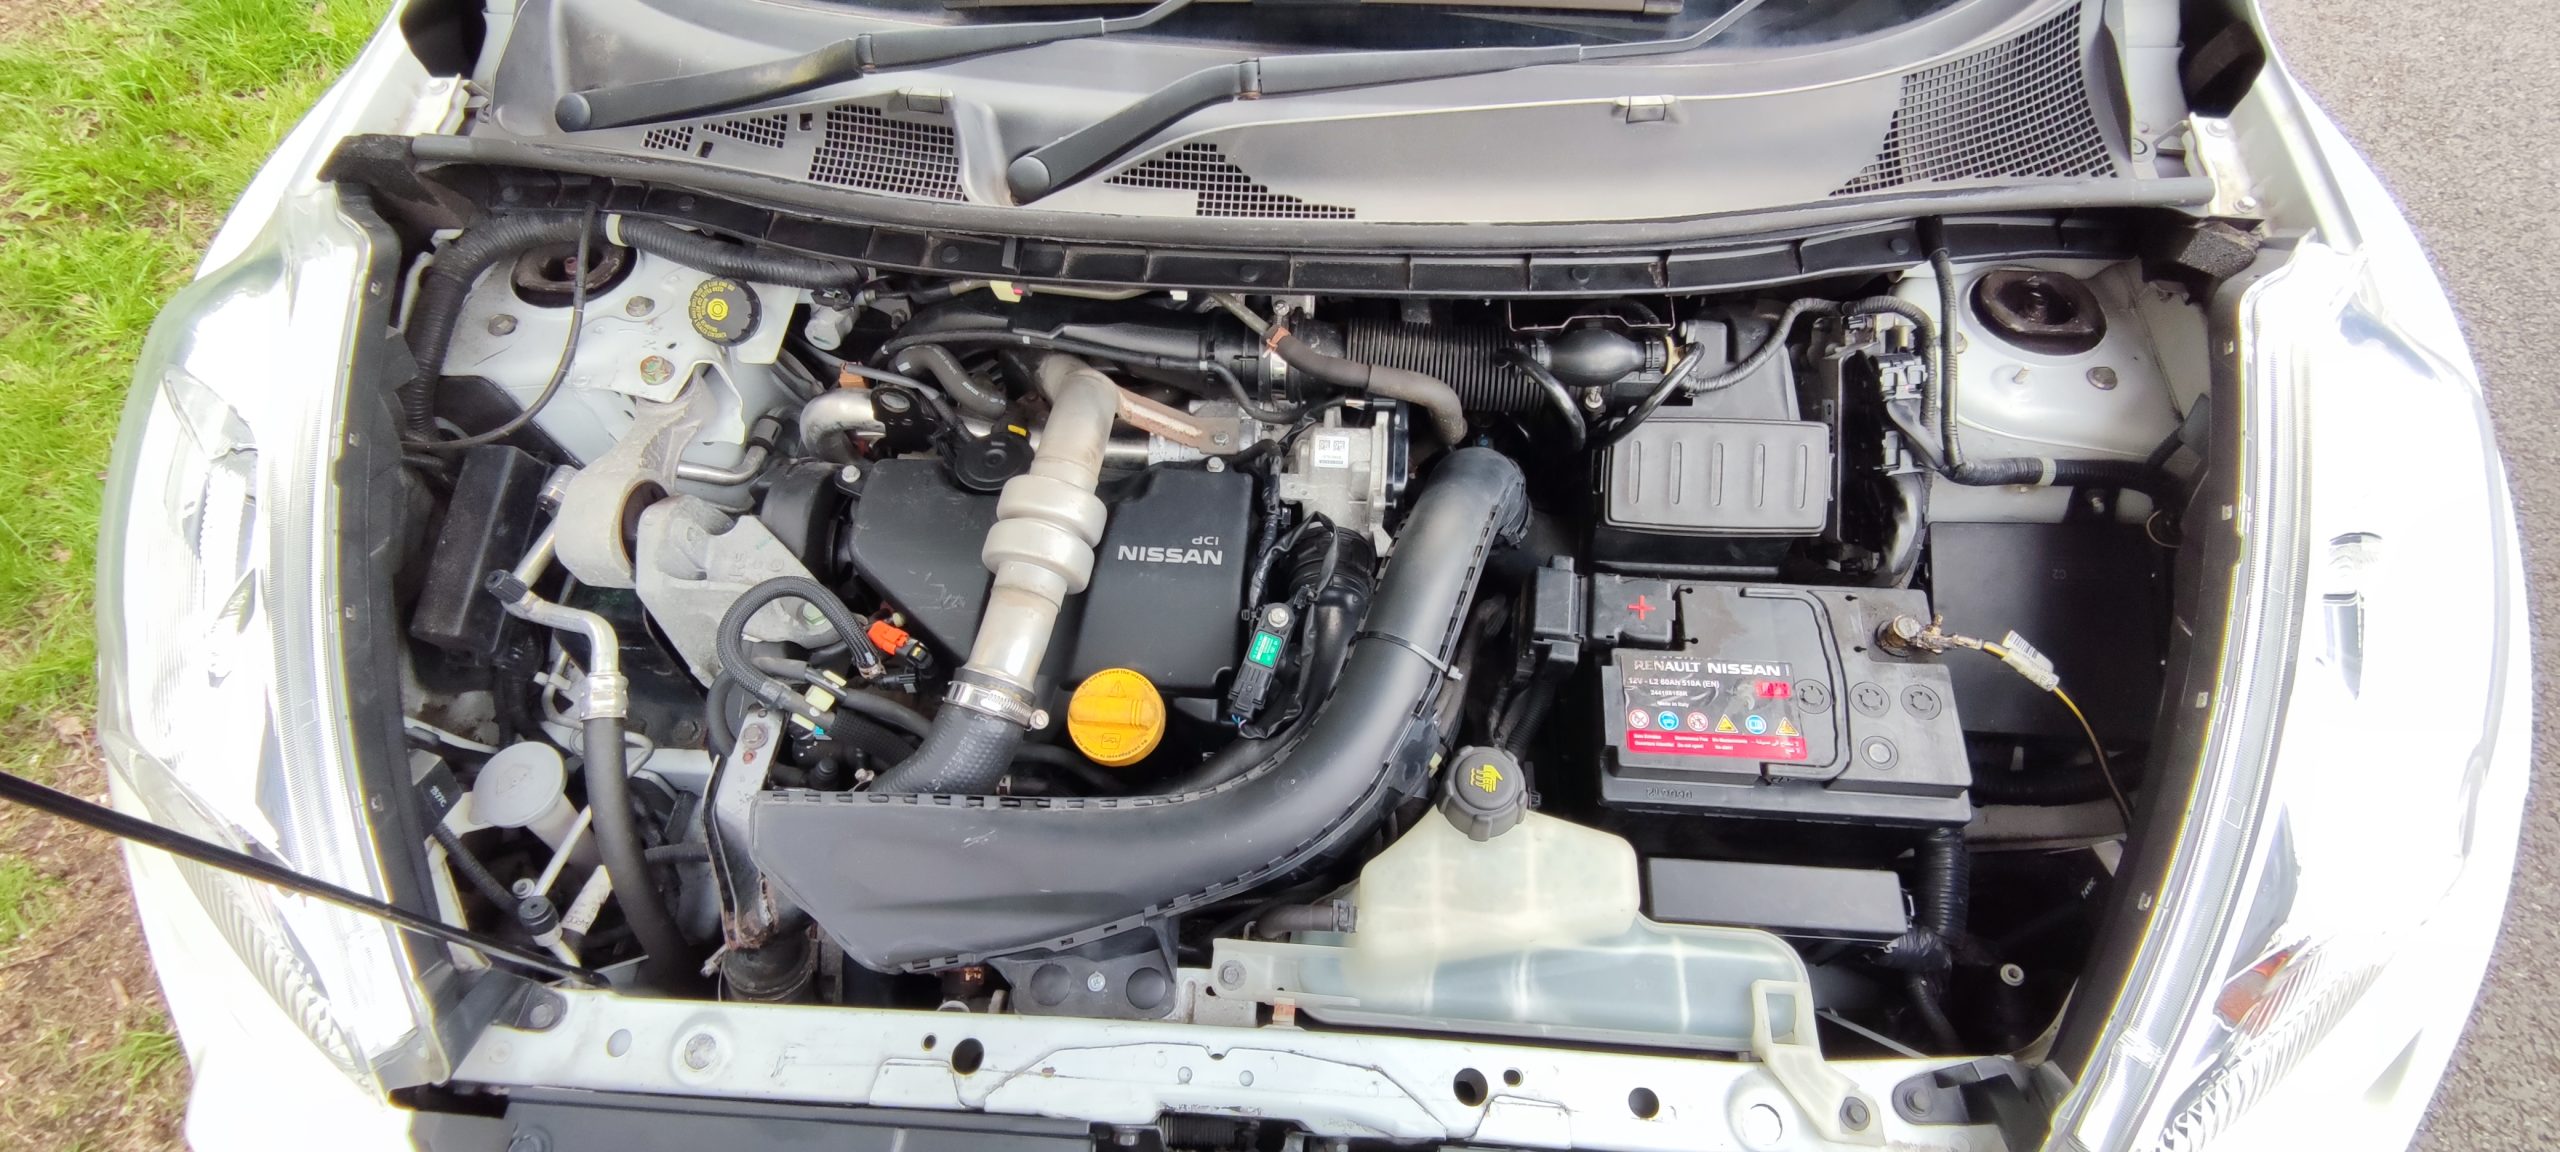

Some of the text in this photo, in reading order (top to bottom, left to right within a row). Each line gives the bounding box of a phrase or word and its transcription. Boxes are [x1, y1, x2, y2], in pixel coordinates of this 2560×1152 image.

[1117, 545, 1223, 566] NISSAN
[1633, 659, 1781, 677] RENAULT NISSAN
